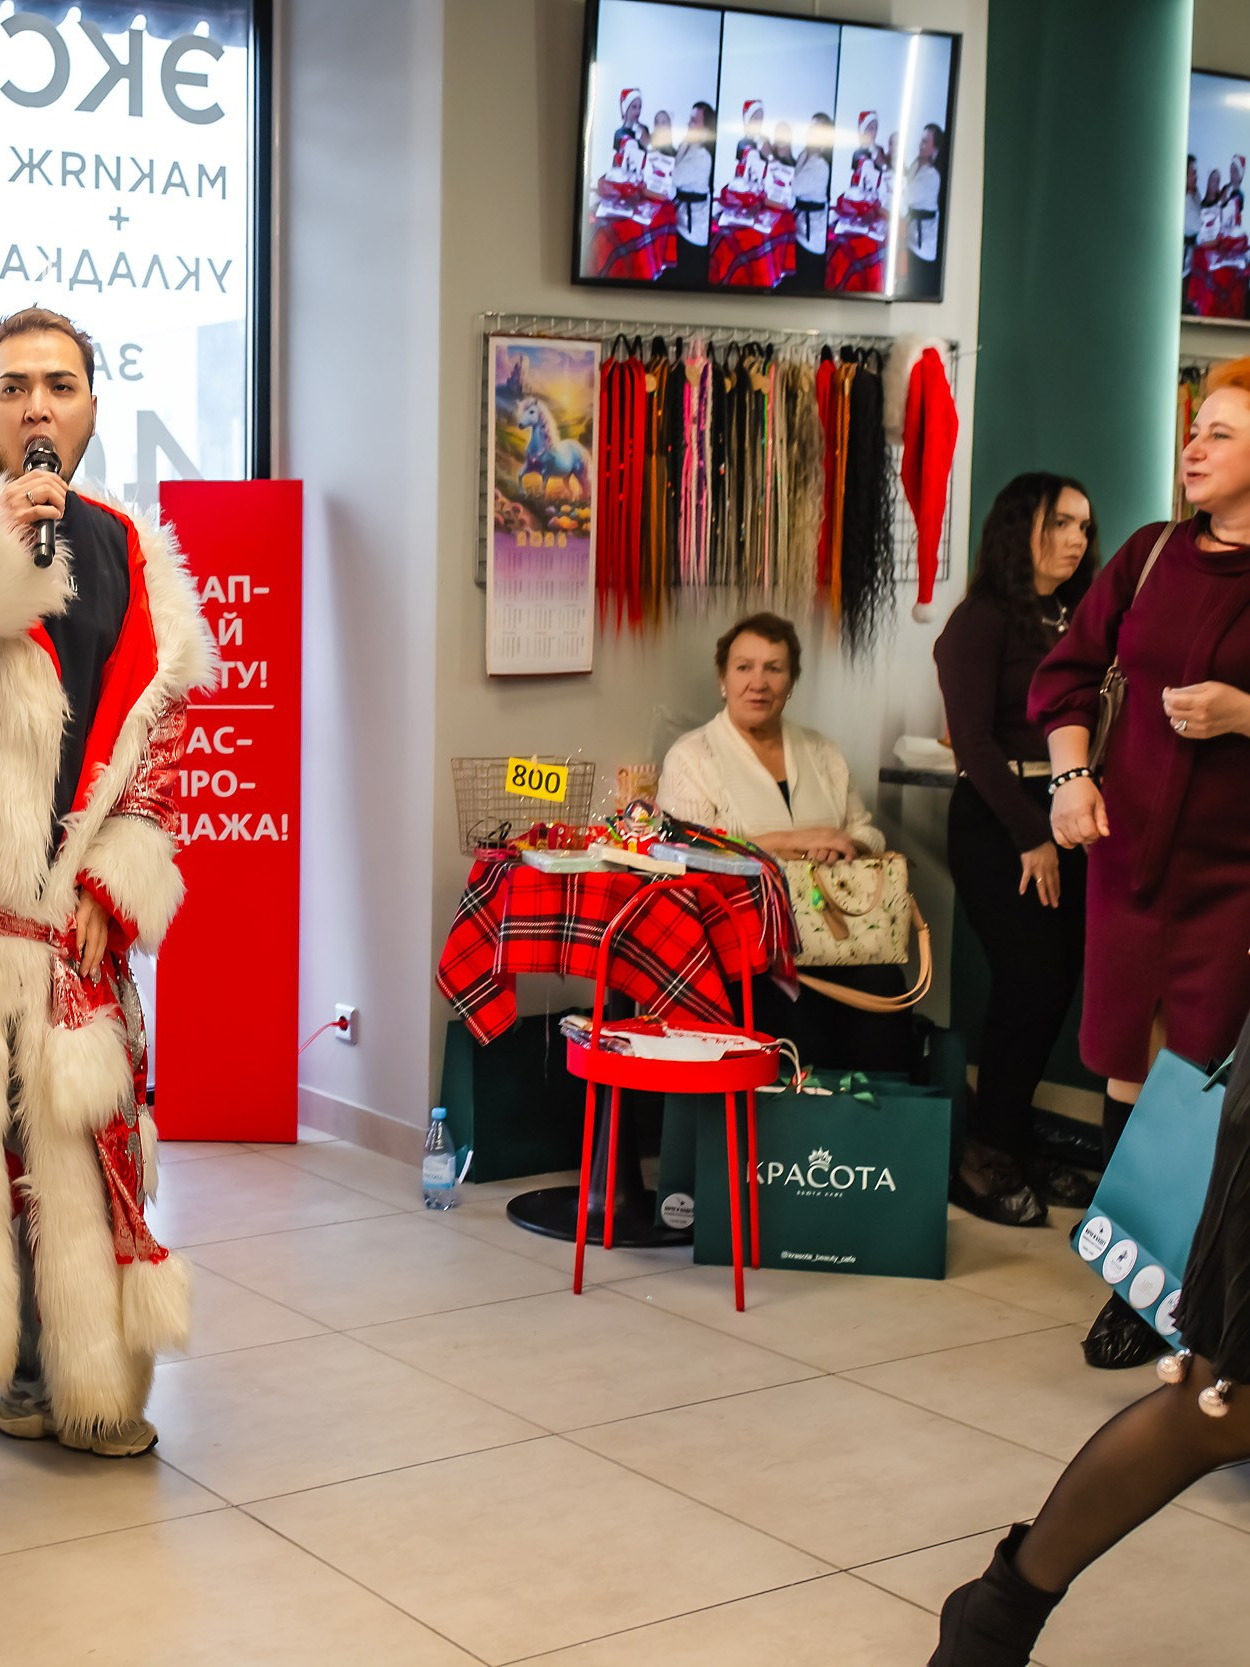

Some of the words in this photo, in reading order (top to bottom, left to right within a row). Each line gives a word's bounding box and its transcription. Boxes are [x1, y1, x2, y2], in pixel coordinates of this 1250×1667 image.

[191, 575, 270, 604] АП-
[217, 660, 268, 689] ТУ!
[186, 726, 253, 755] АС-
[512, 764, 561, 794] 800
[747, 1160, 897, 1193] КРАСОТА
